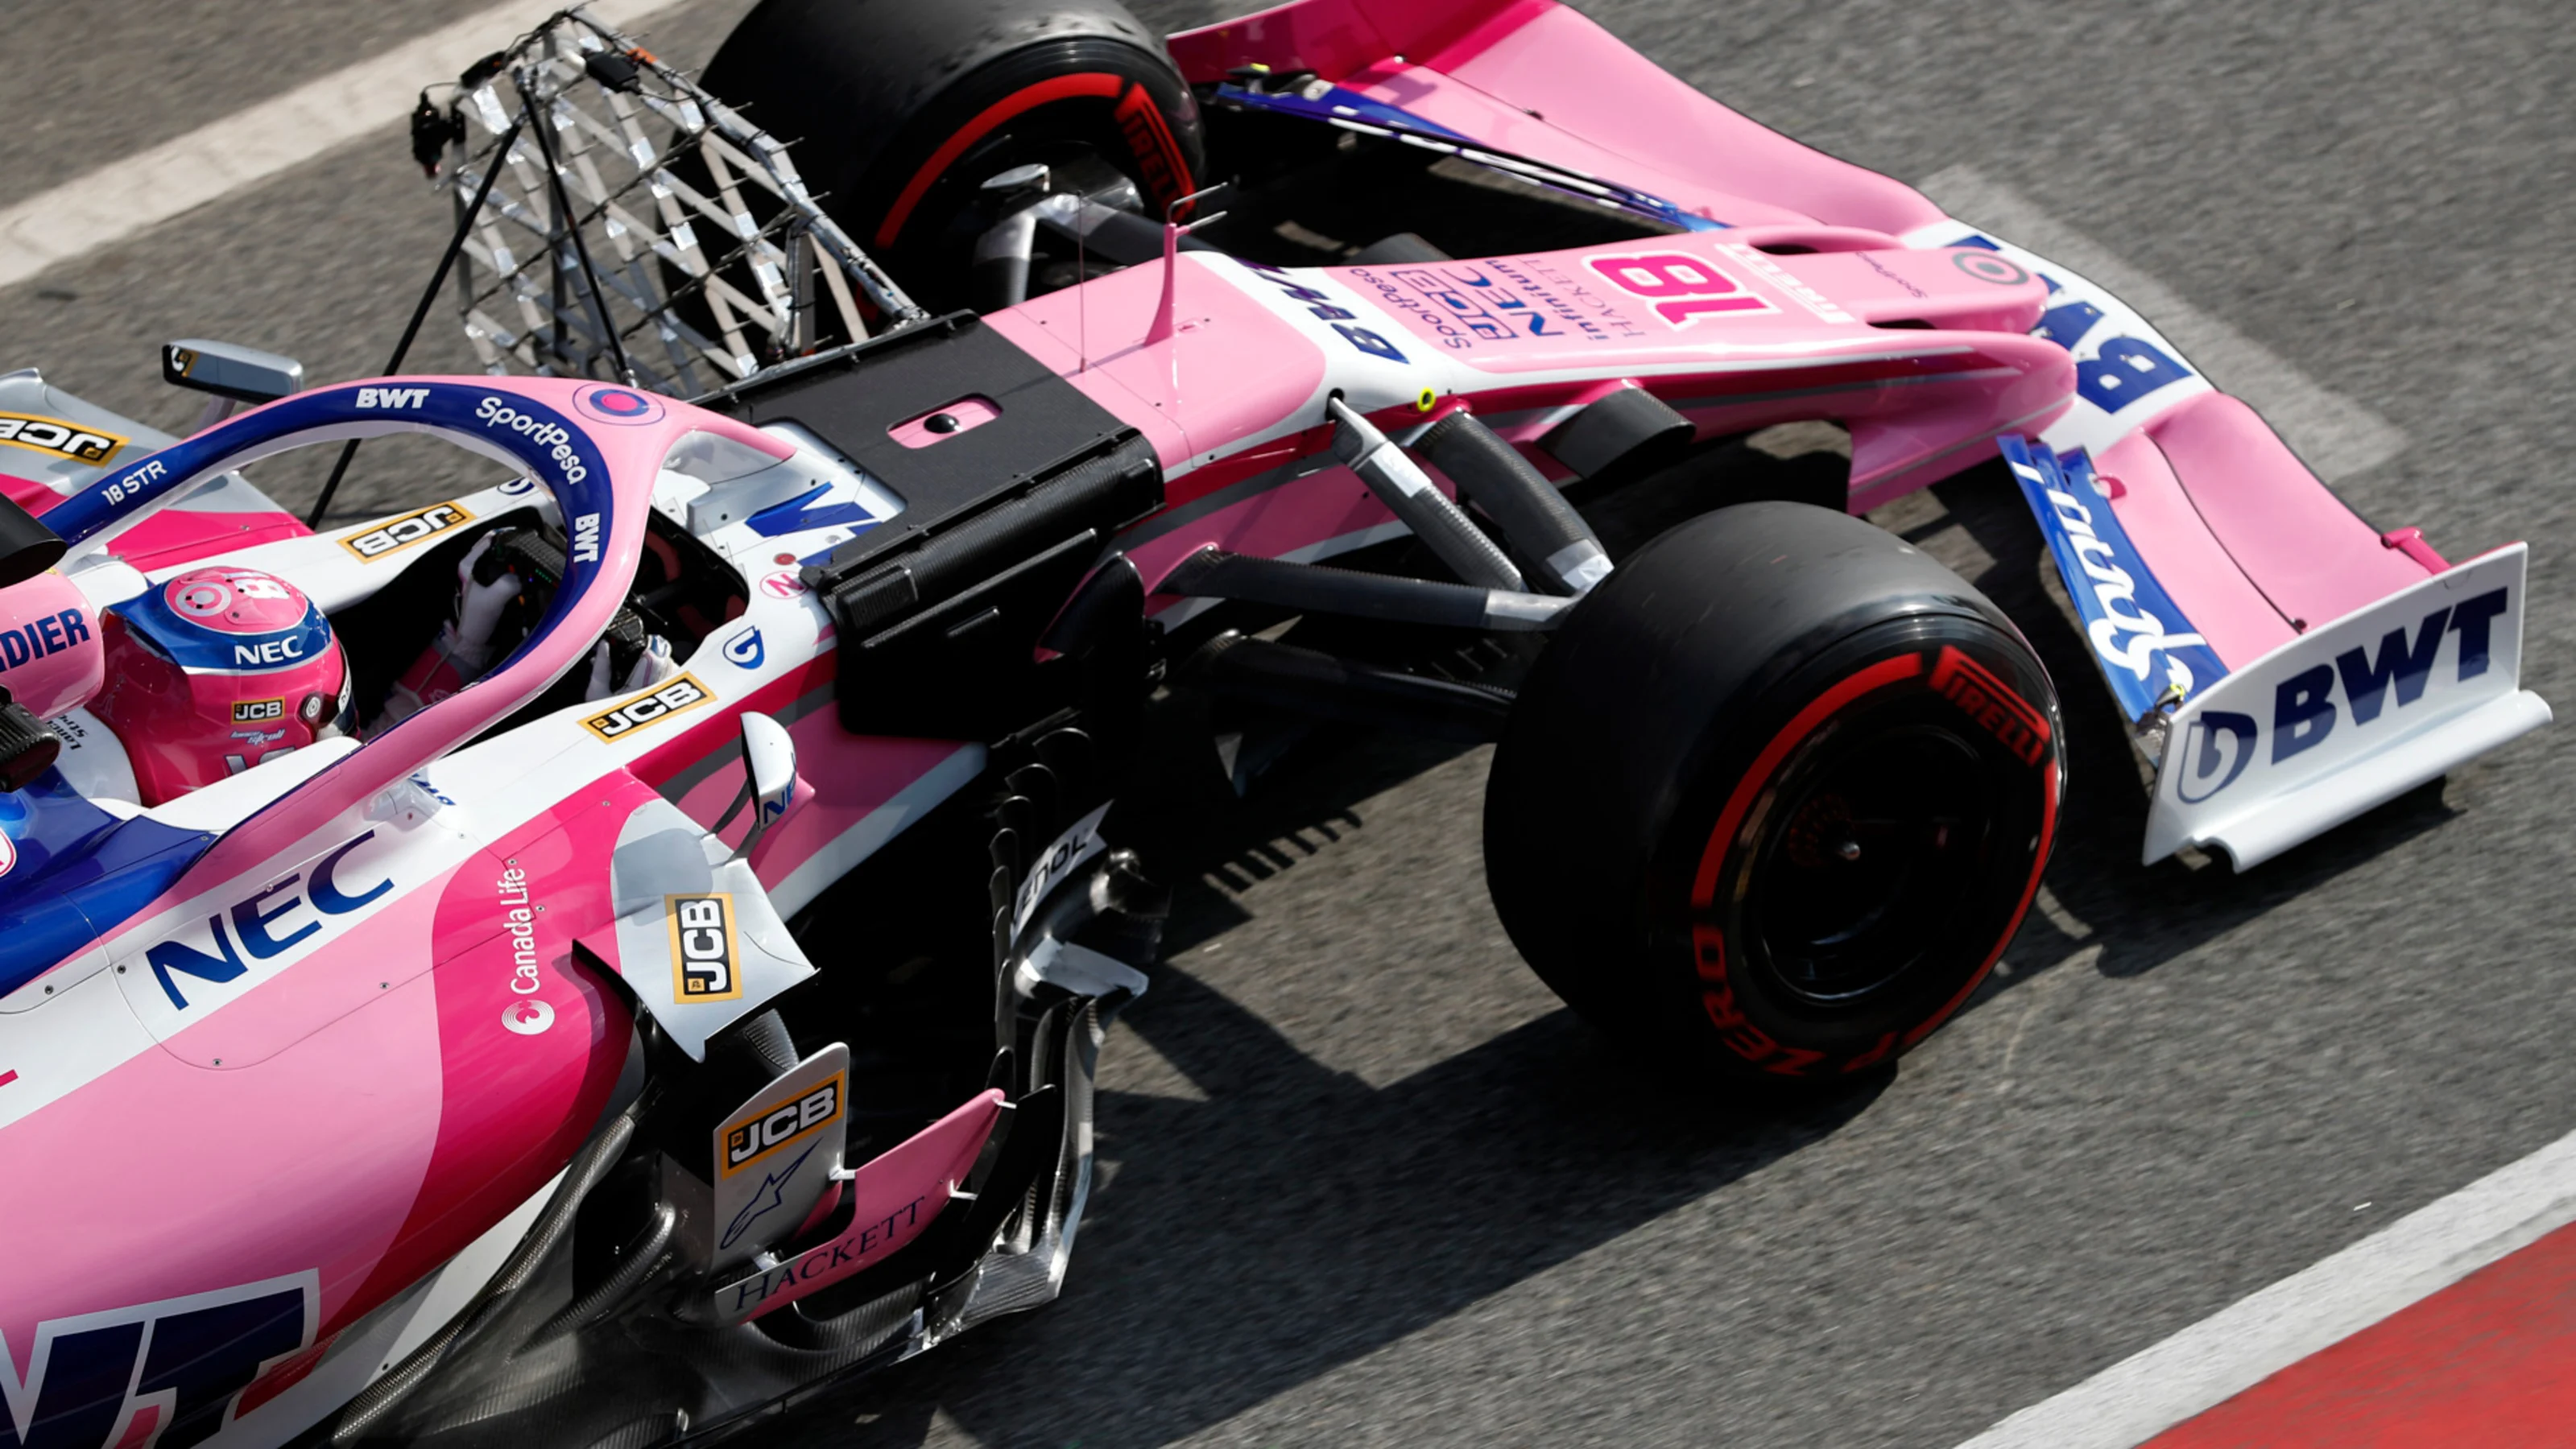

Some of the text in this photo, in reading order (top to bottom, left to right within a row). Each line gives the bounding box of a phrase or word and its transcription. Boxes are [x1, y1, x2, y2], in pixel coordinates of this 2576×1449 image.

[1350, 267, 1472, 349] SportPesa
[1390, 269, 1520, 340] JCB
[1440, 266, 1565, 336] NEC
[1583, 250, 1781, 331] 18
[355, 388, 430, 409] BWT
[475, 397, 587, 485] SportPesa
[101, 460, 167, 506] 18 STR
[351, 506, 454, 556] JCB
[573, 512, 600, 564] BWT
[234, 635, 303, 665] NEC
[2271, 585, 2509, 766] BWT
[234, 701, 283, 720] JCB
[602, 682, 702, 736] JCB
[1931, 645, 2052, 767] PIRELLI
[145, 829, 395, 1011] NEC
[497, 868, 540, 995] Canada Life
[680, 899, 728, 993] JCB
[1693, 922, 1826, 1076] ZERO
[730, 1087, 835, 1163] JCB
[734, 1195, 925, 1311] HACKETT
